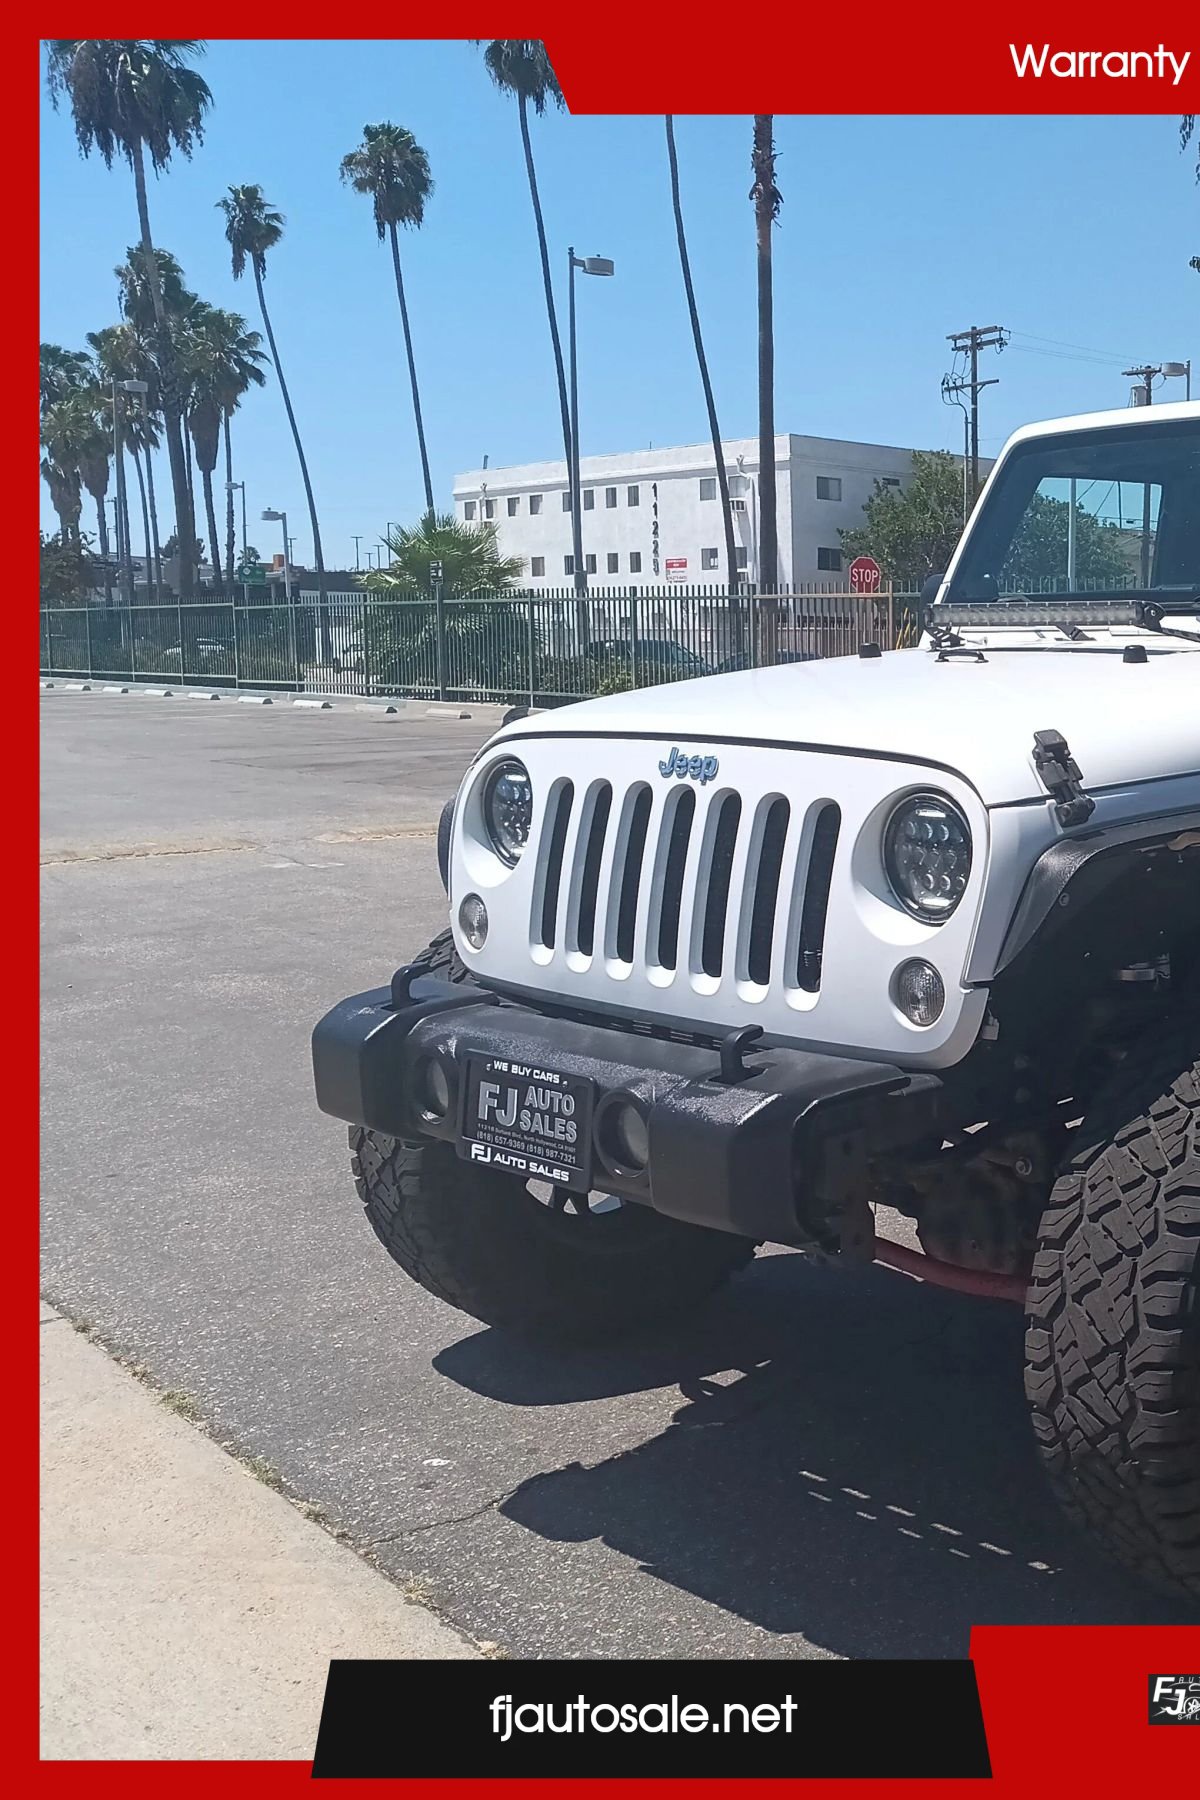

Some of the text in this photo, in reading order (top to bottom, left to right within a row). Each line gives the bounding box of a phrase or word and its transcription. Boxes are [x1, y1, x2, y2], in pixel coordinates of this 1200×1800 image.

[852, 568, 878, 582] STOP
[658, 746, 720, 786] Jeep
[494, 1060, 560, 1084] WE BUY CARS
[478, 1080, 518, 1127] FJ
[524, 1086, 575, 1116] AUTO
[520, 1110, 577, 1144] SALES
[471, 1143, 570, 1182] FJ AUTO SALES
[476, 1130, 576, 1164] (818) 657-9369 (818) 987-7321
